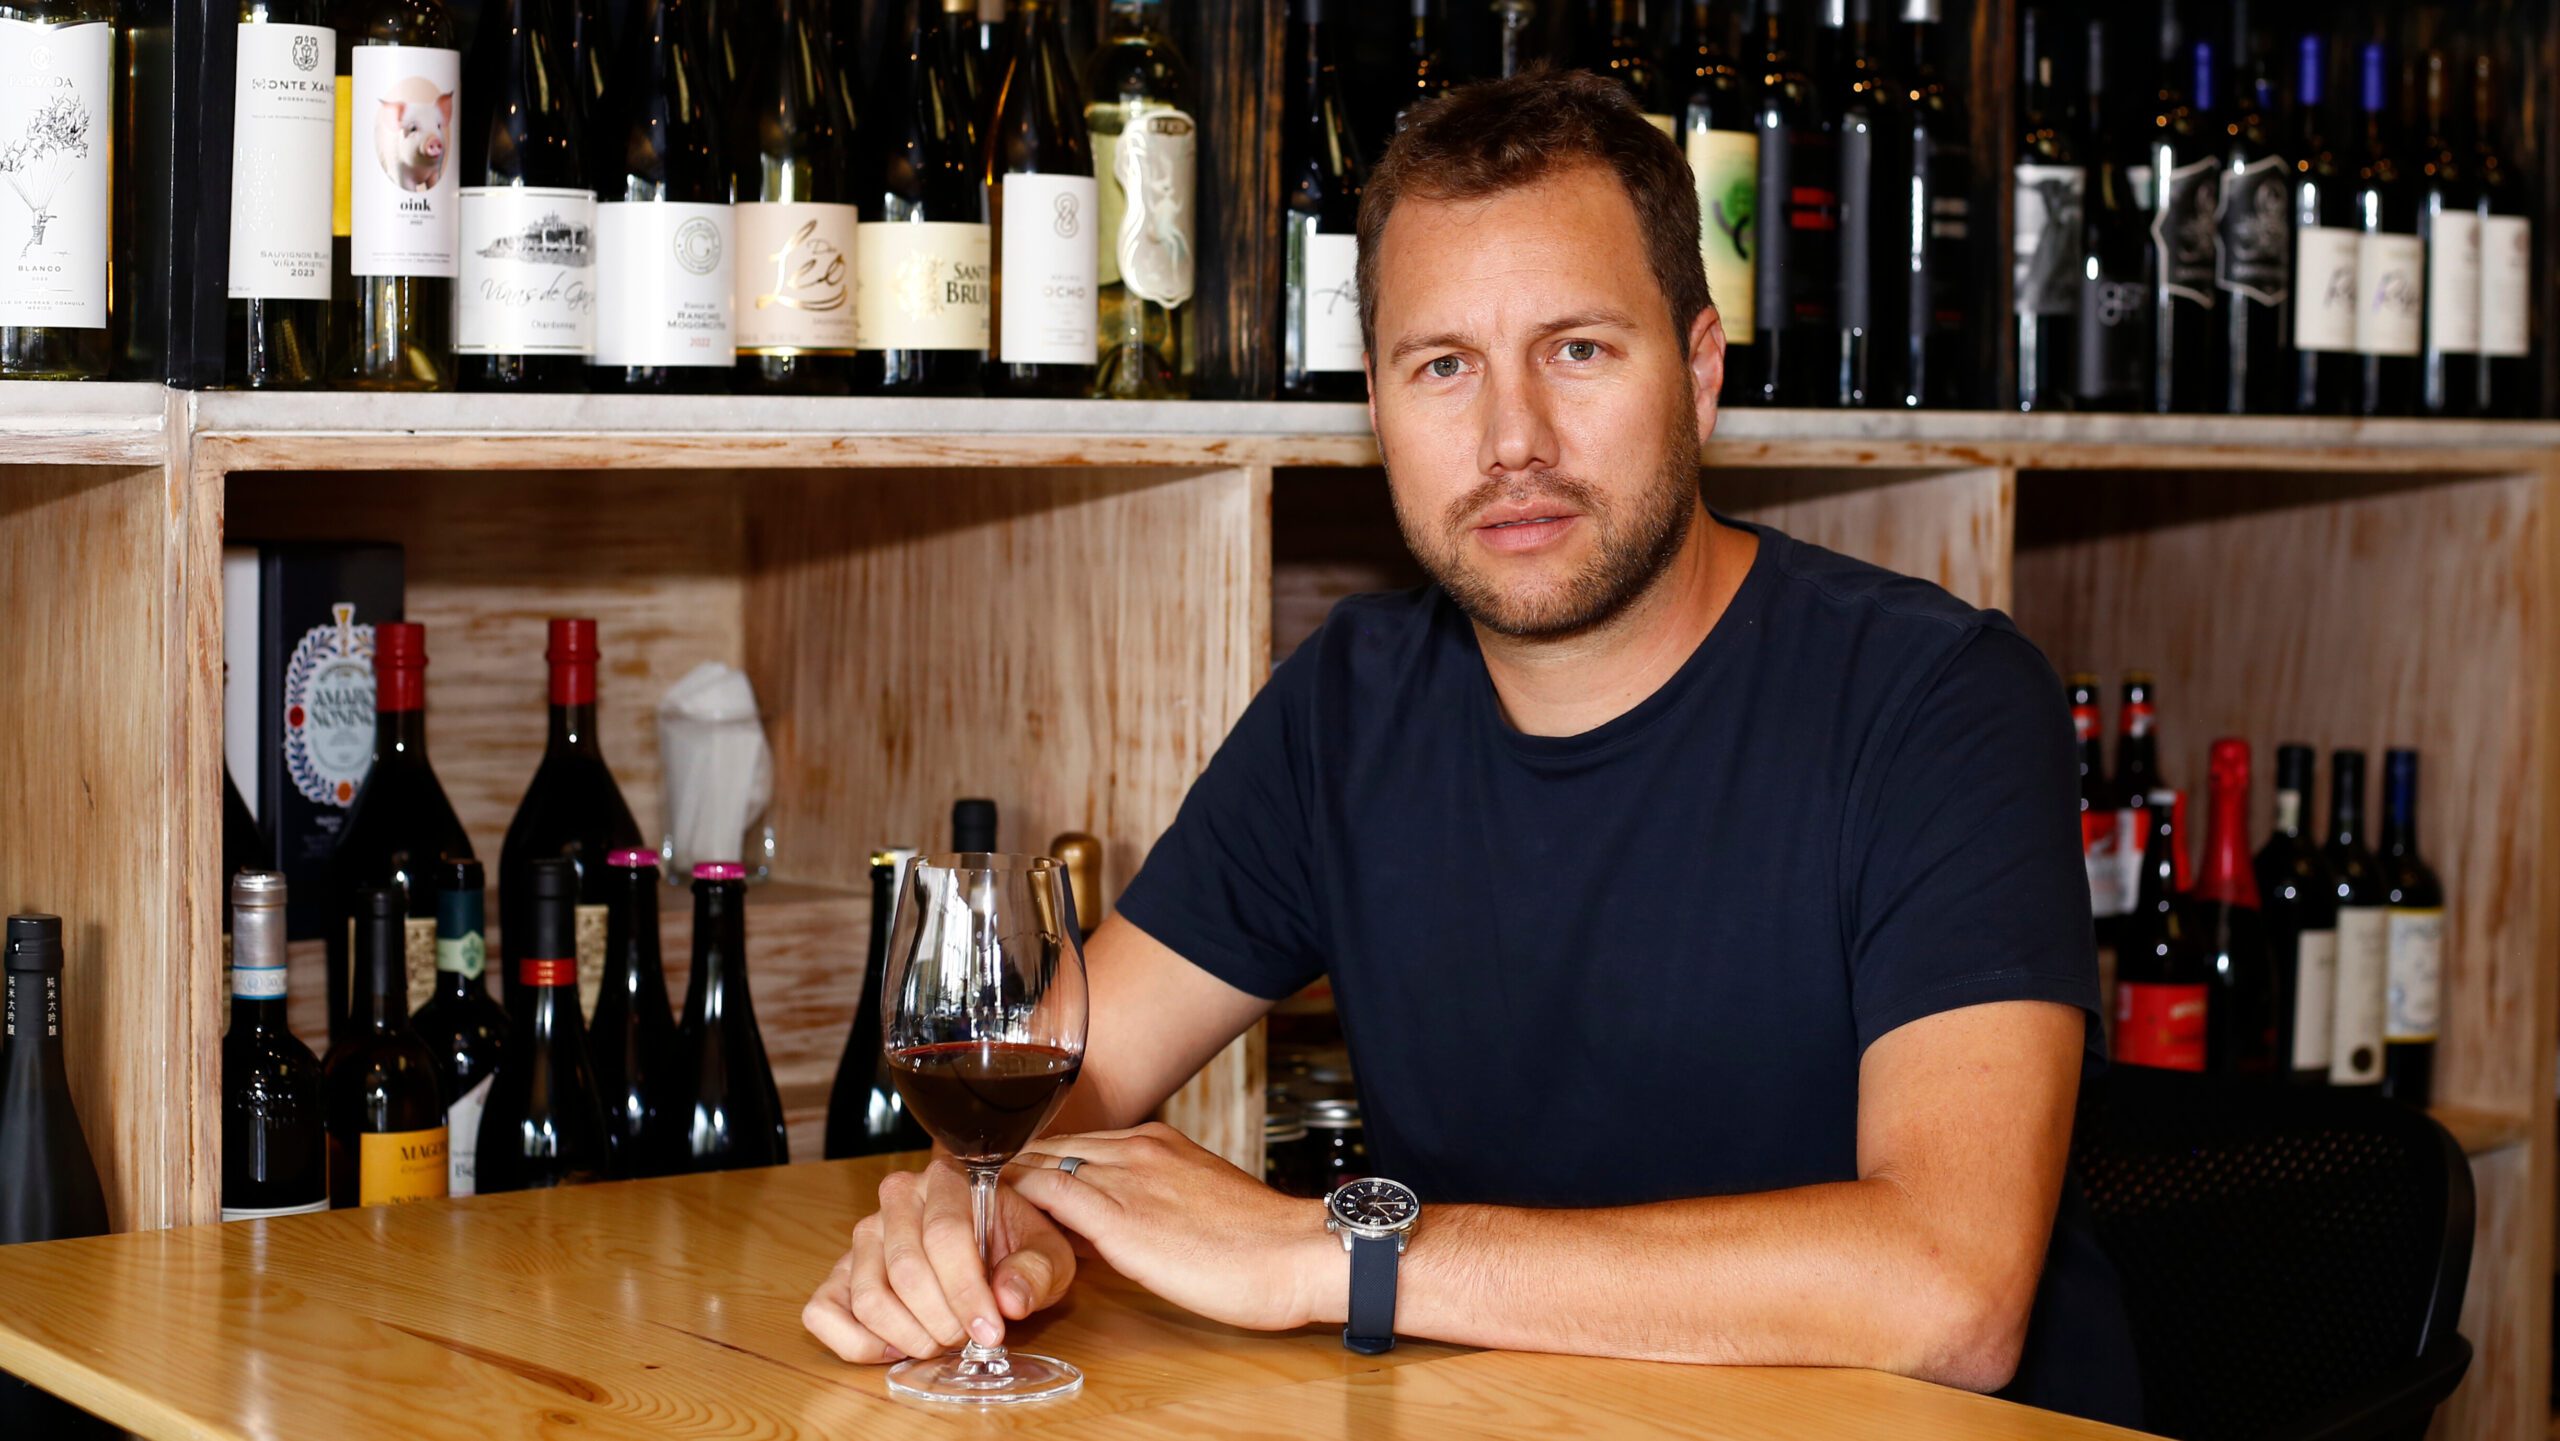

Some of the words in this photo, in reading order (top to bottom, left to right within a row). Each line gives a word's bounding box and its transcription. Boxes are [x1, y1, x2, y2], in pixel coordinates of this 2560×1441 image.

[252, 79, 307, 91] MONTE
[400, 198, 431, 211] oink
[18, 265, 62, 273] BLANCO
[291, 268, 315, 277] 2023
[954, 260, 987, 281] SANT
[1043, 286, 1086, 299] OCHO
